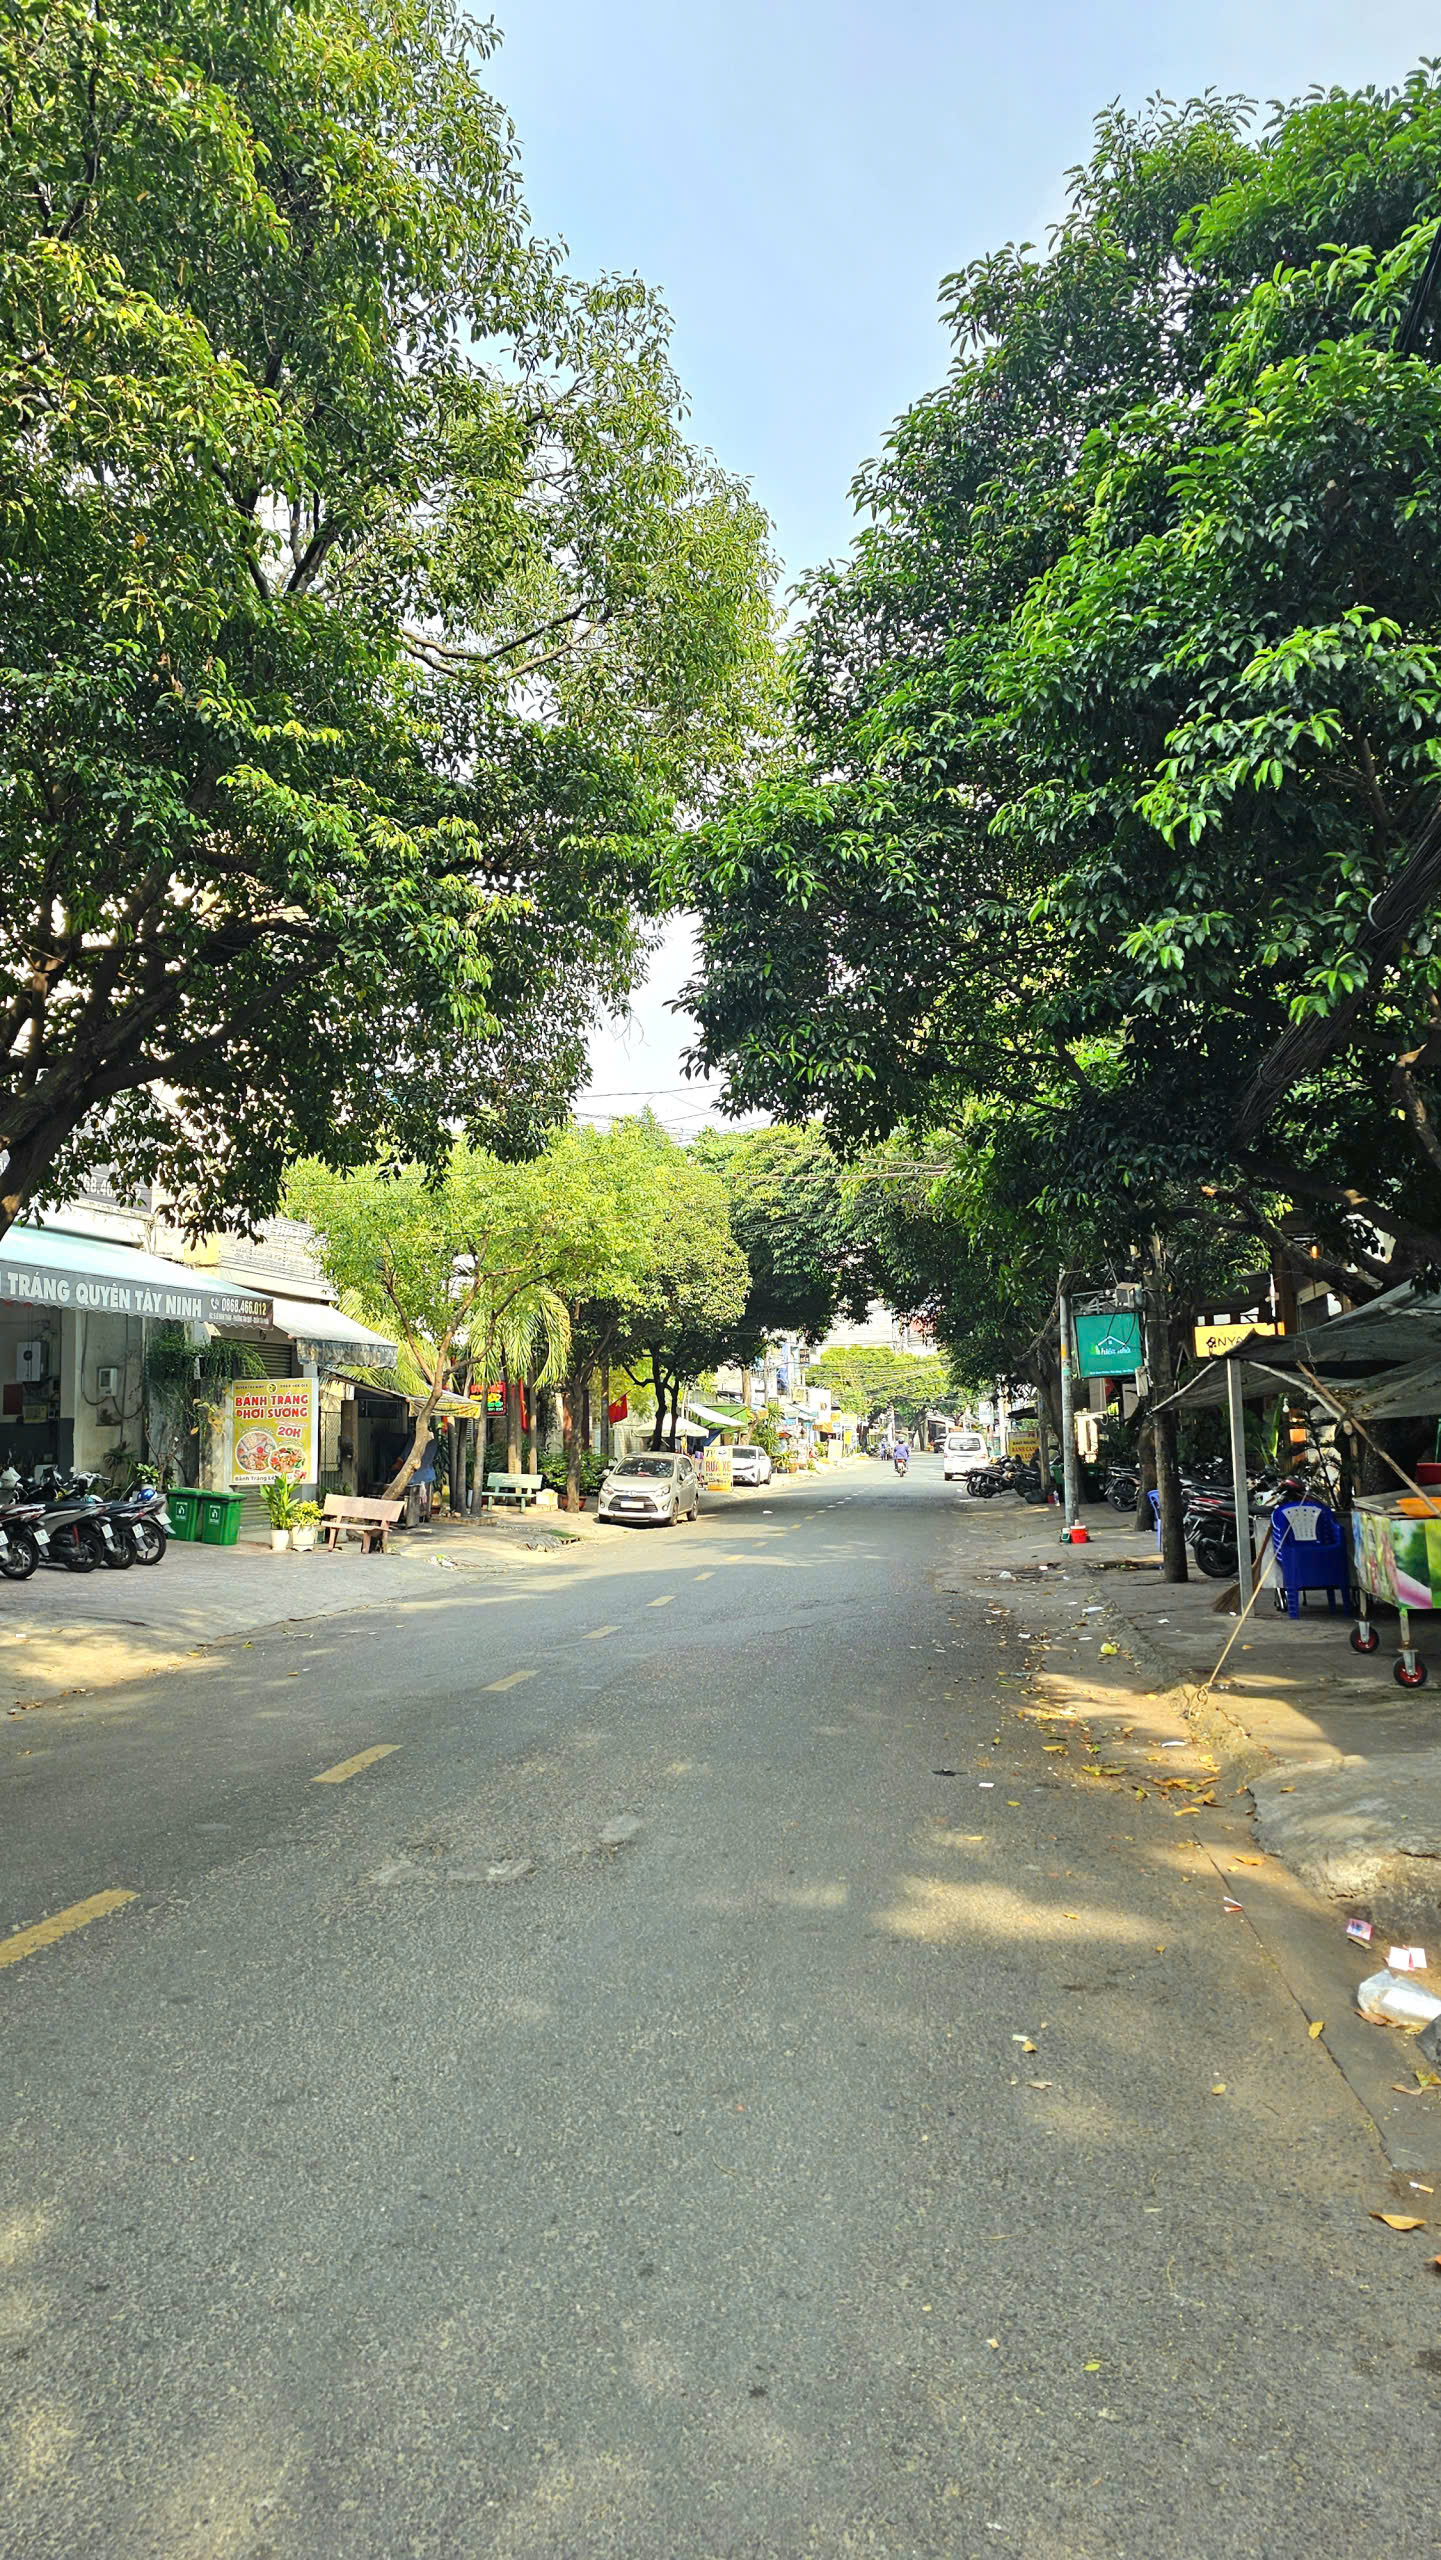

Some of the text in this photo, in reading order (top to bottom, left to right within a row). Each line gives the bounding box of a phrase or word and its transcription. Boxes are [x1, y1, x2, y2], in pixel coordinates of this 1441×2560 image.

[8, 1271, 267, 1317] TRÁNG QUYÊN TÂY NINH 0868.466.012
[235, 1392, 308, 1406] BÁNH TRÁNG
[277, 1426, 301, 1438] 20H
